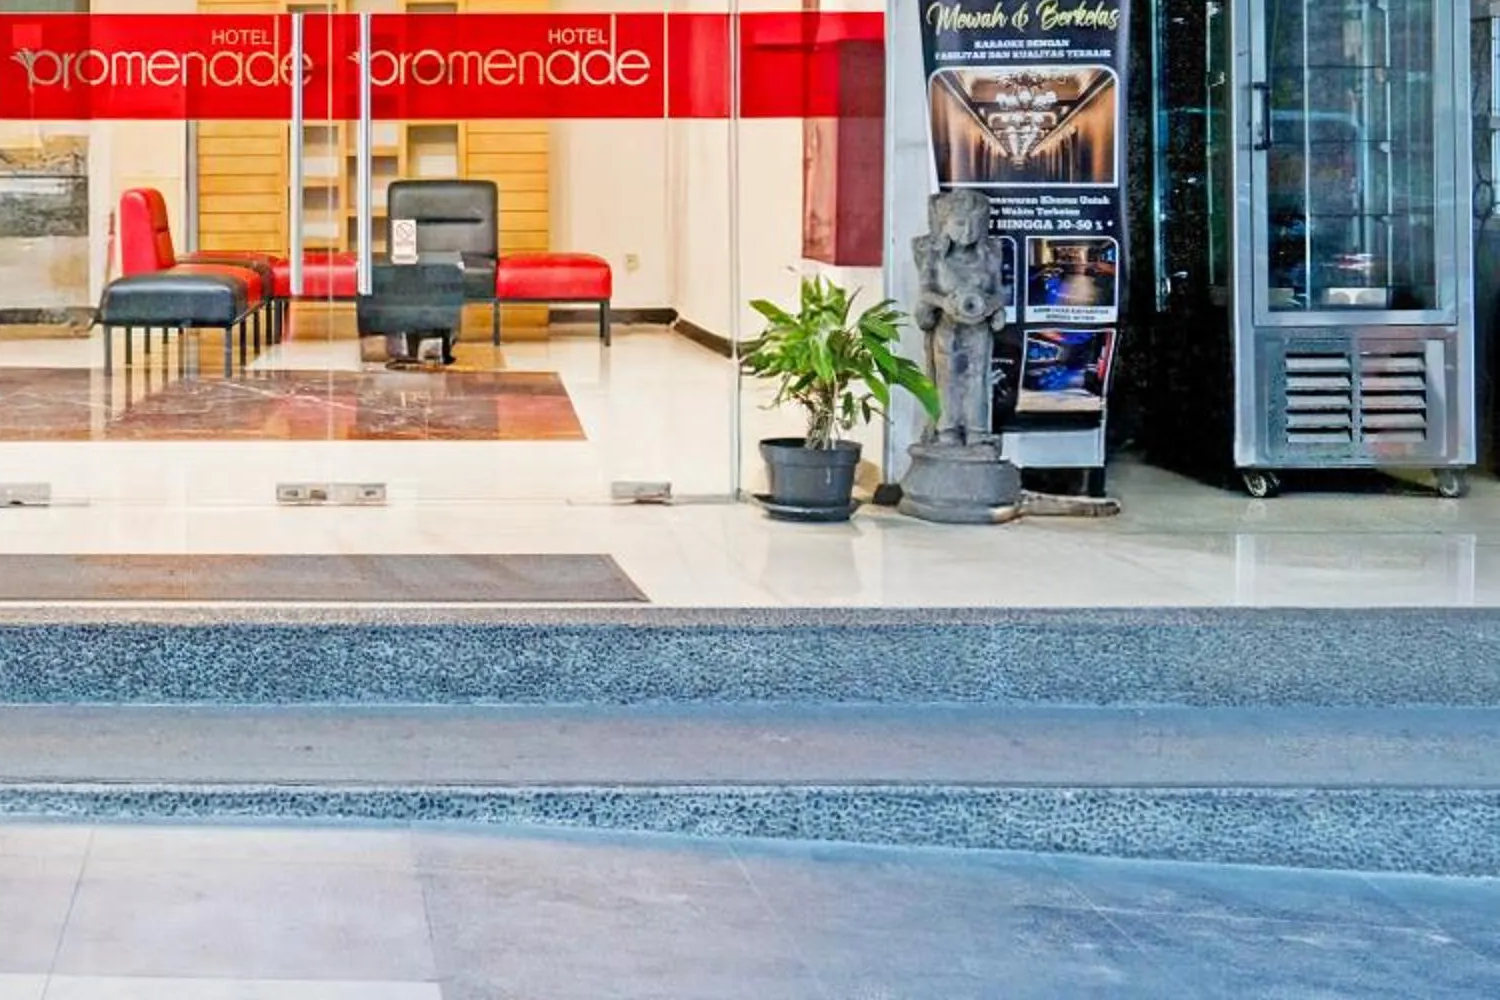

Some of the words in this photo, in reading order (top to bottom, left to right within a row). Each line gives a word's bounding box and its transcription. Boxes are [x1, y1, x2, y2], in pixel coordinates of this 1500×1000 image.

[926, 1, 1008, 36] Mewah
[212, 29, 272, 46] HOTEL
[547, 28, 609, 45] HOTEL
[348, 14, 651, 87] promenade
[997, 219, 1053, 230] HINGGA
